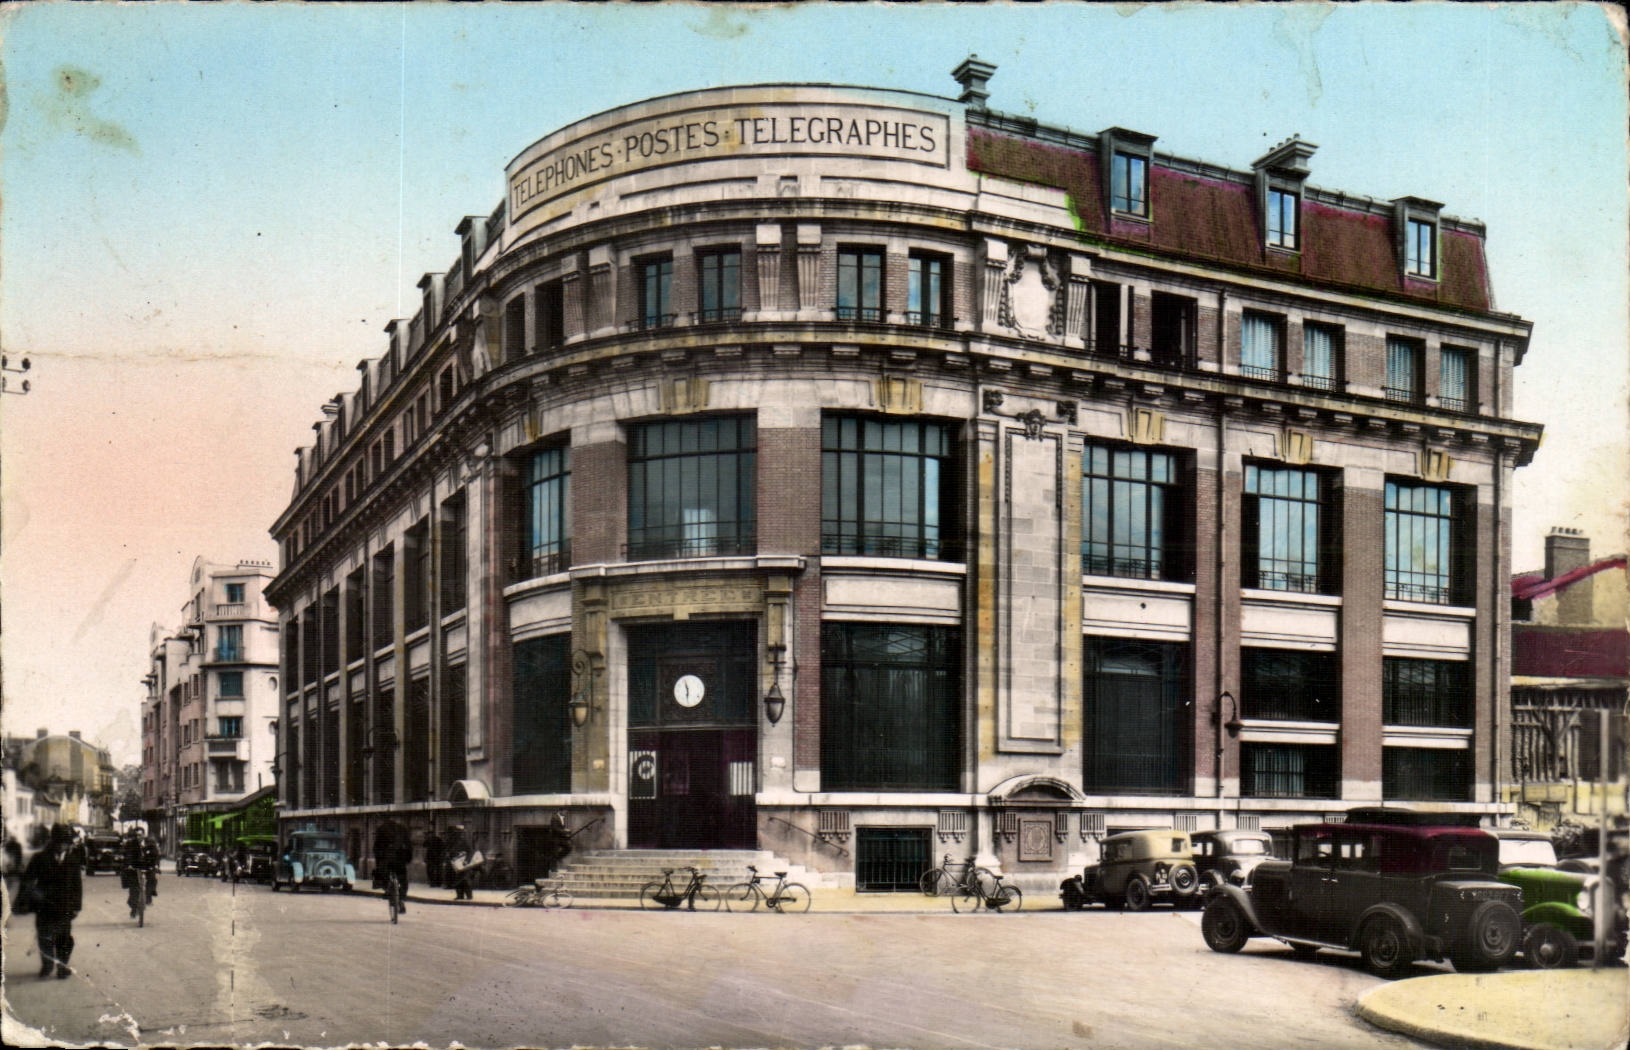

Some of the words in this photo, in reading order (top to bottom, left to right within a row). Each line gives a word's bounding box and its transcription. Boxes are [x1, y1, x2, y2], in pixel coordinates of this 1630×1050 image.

[514, 142, 614, 209] TELEPHONES
[624, 121, 720, 162] POSTES
[734, 117, 937, 153] TELEGRAPHES
